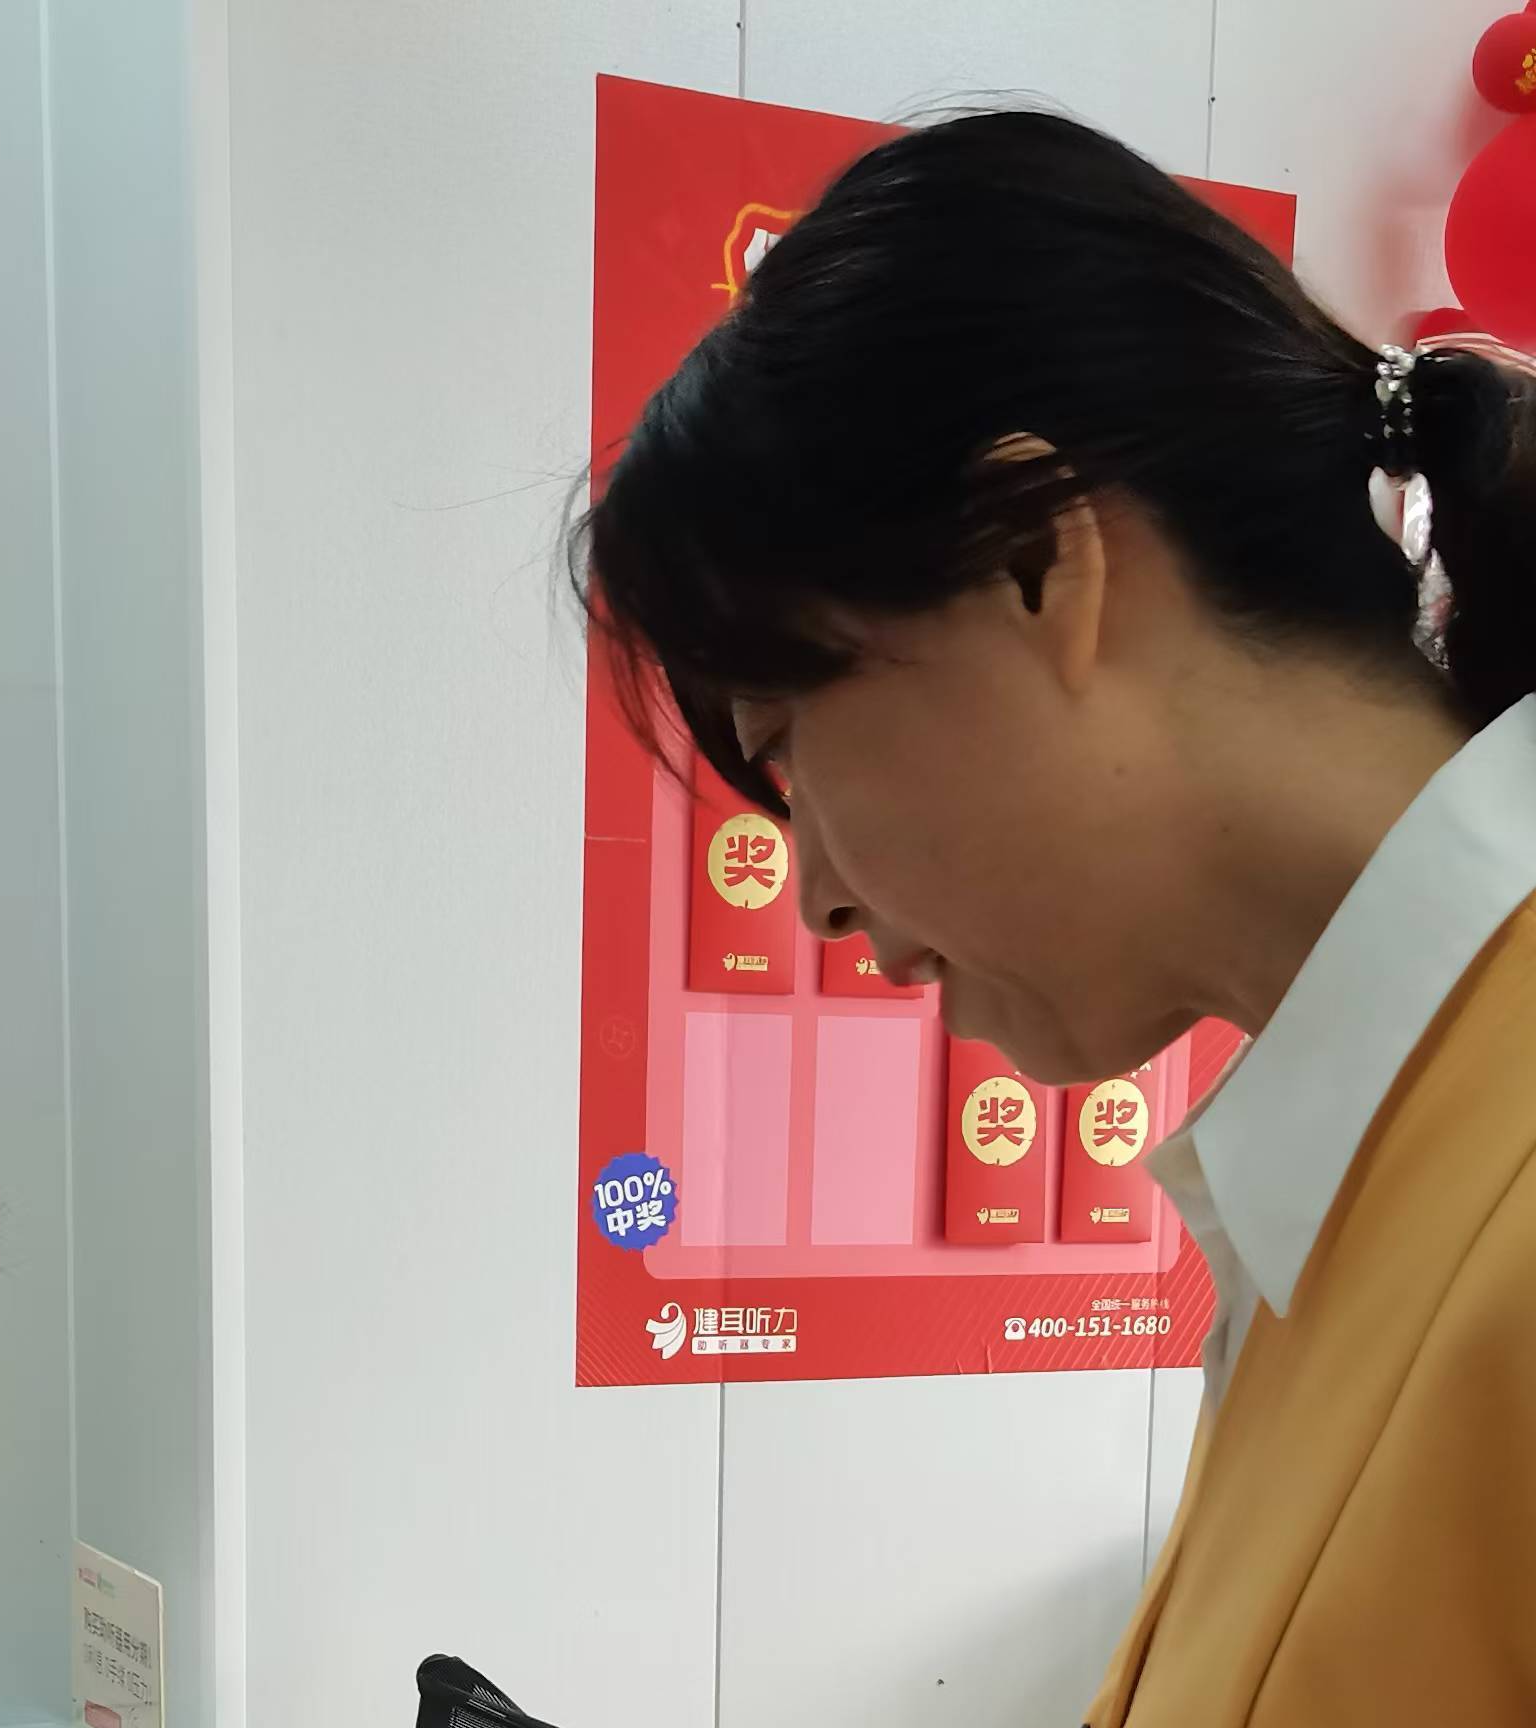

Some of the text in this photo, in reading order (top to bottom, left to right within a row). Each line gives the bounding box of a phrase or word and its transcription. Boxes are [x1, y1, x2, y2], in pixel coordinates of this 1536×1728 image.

[723, 834, 776, 889] 奖
[976, 1097, 1025, 1147] 奖
[1092, 1099, 1138, 1147] 奖
[594, 1169, 672, 1210] 100%
[606, 1200, 667, 1237] 中奖
[693, 1307, 798, 1335] 健耳听力
[1028, 1315, 1171, 1338] 400-151-1680
